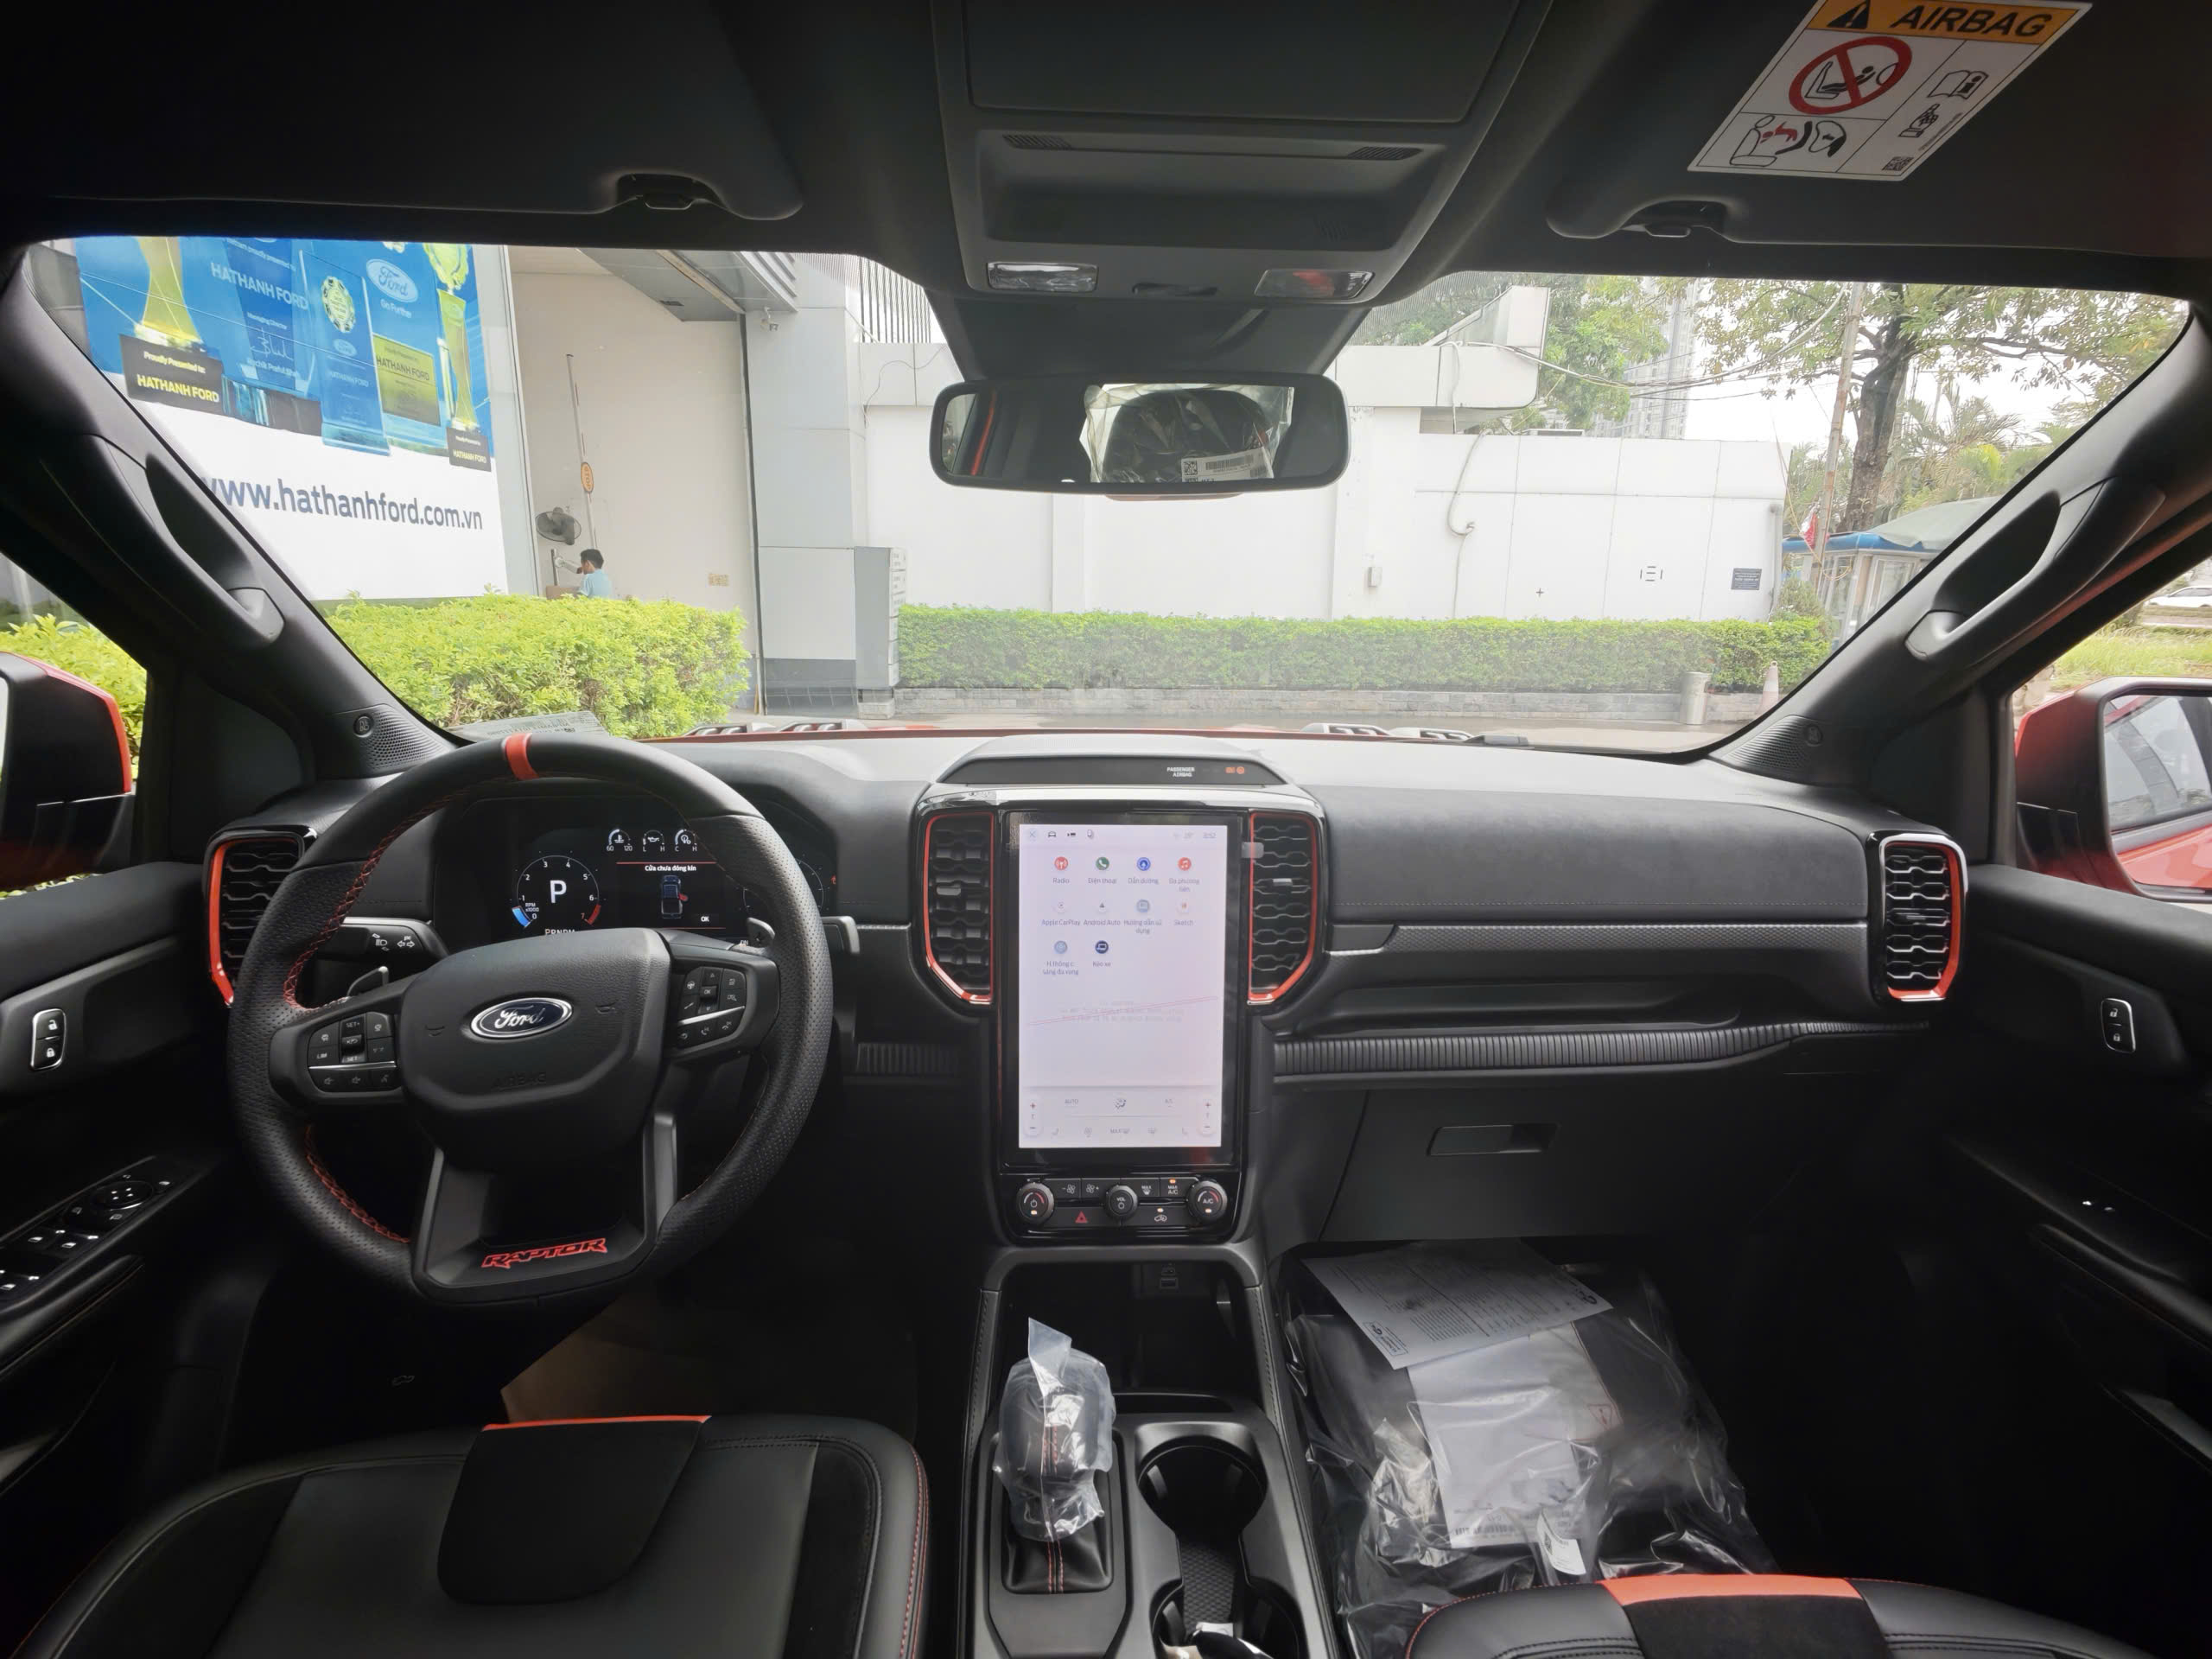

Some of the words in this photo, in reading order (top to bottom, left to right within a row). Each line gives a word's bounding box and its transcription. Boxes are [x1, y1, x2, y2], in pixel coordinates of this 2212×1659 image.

[1889, 5, 2053, 37] AIRBAG
[210, 262, 276, 298] HATHANH
[276, 287, 308, 310] FORD
[378, 265, 409, 297] Ford
[376, 355, 411, 375] HATHANH
[411, 366, 429, 381] FORD
[137, 373, 191, 397] HATHANH
[191, 385, 219, 403] FORD
[550, 880, 567, 904] P
[494, 1004, 546, 1029] Ford
[481, 1237, 607, 1268] RAPTOR
